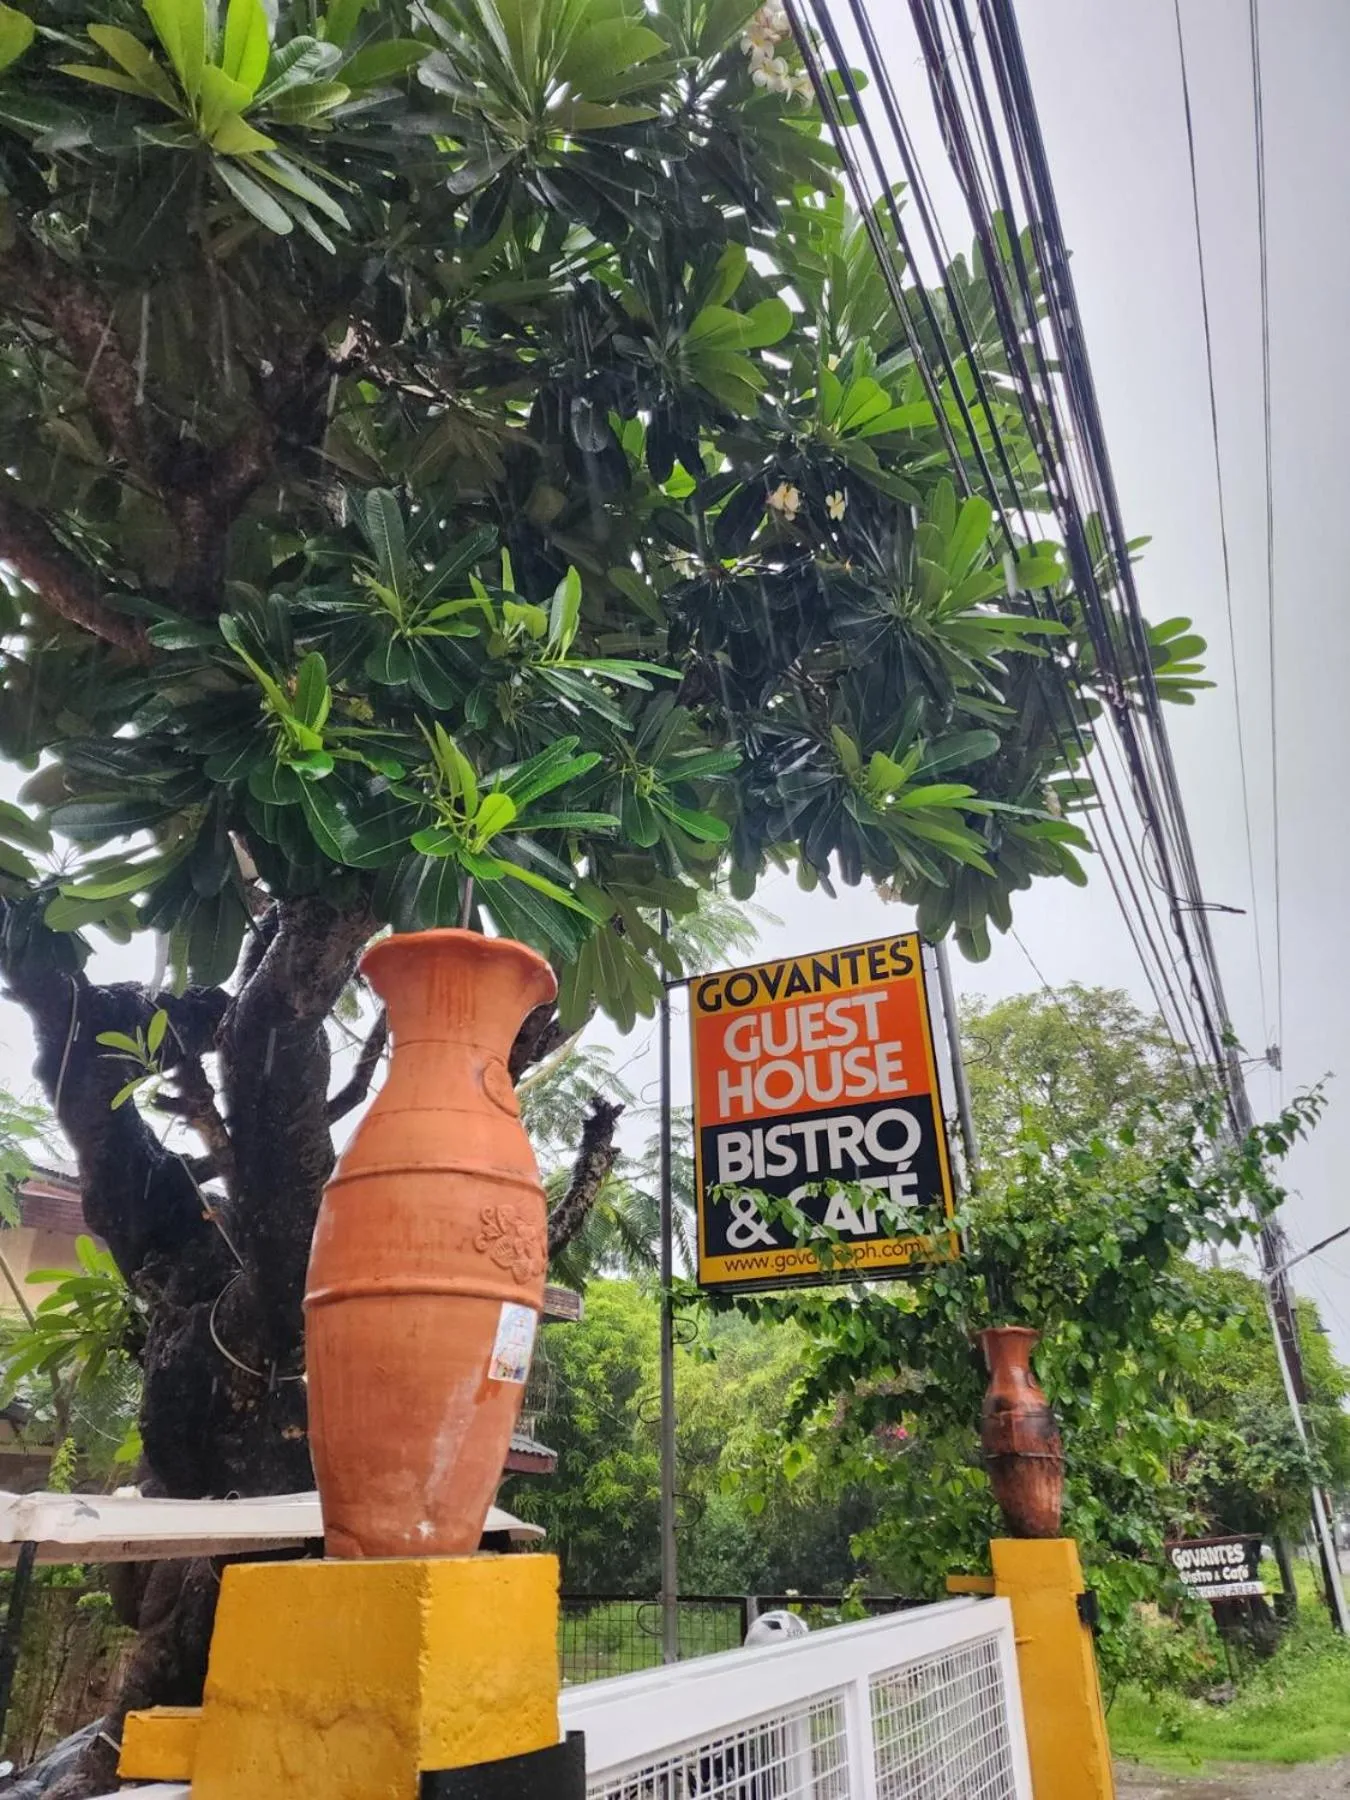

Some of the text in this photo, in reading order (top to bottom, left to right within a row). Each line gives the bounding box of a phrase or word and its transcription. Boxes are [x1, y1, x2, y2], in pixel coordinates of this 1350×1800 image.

[696, 940, 914, 1012] GOVANTES
[723, 991, 888, 1063] GUEST
[718, 1041, 908, 1118] HOUSE
[717, 1108, 922, 1183] BISTRO
[726, 1192, 778, 1249] &
[1171, 1543, 1245, 1570] GOVANTES
